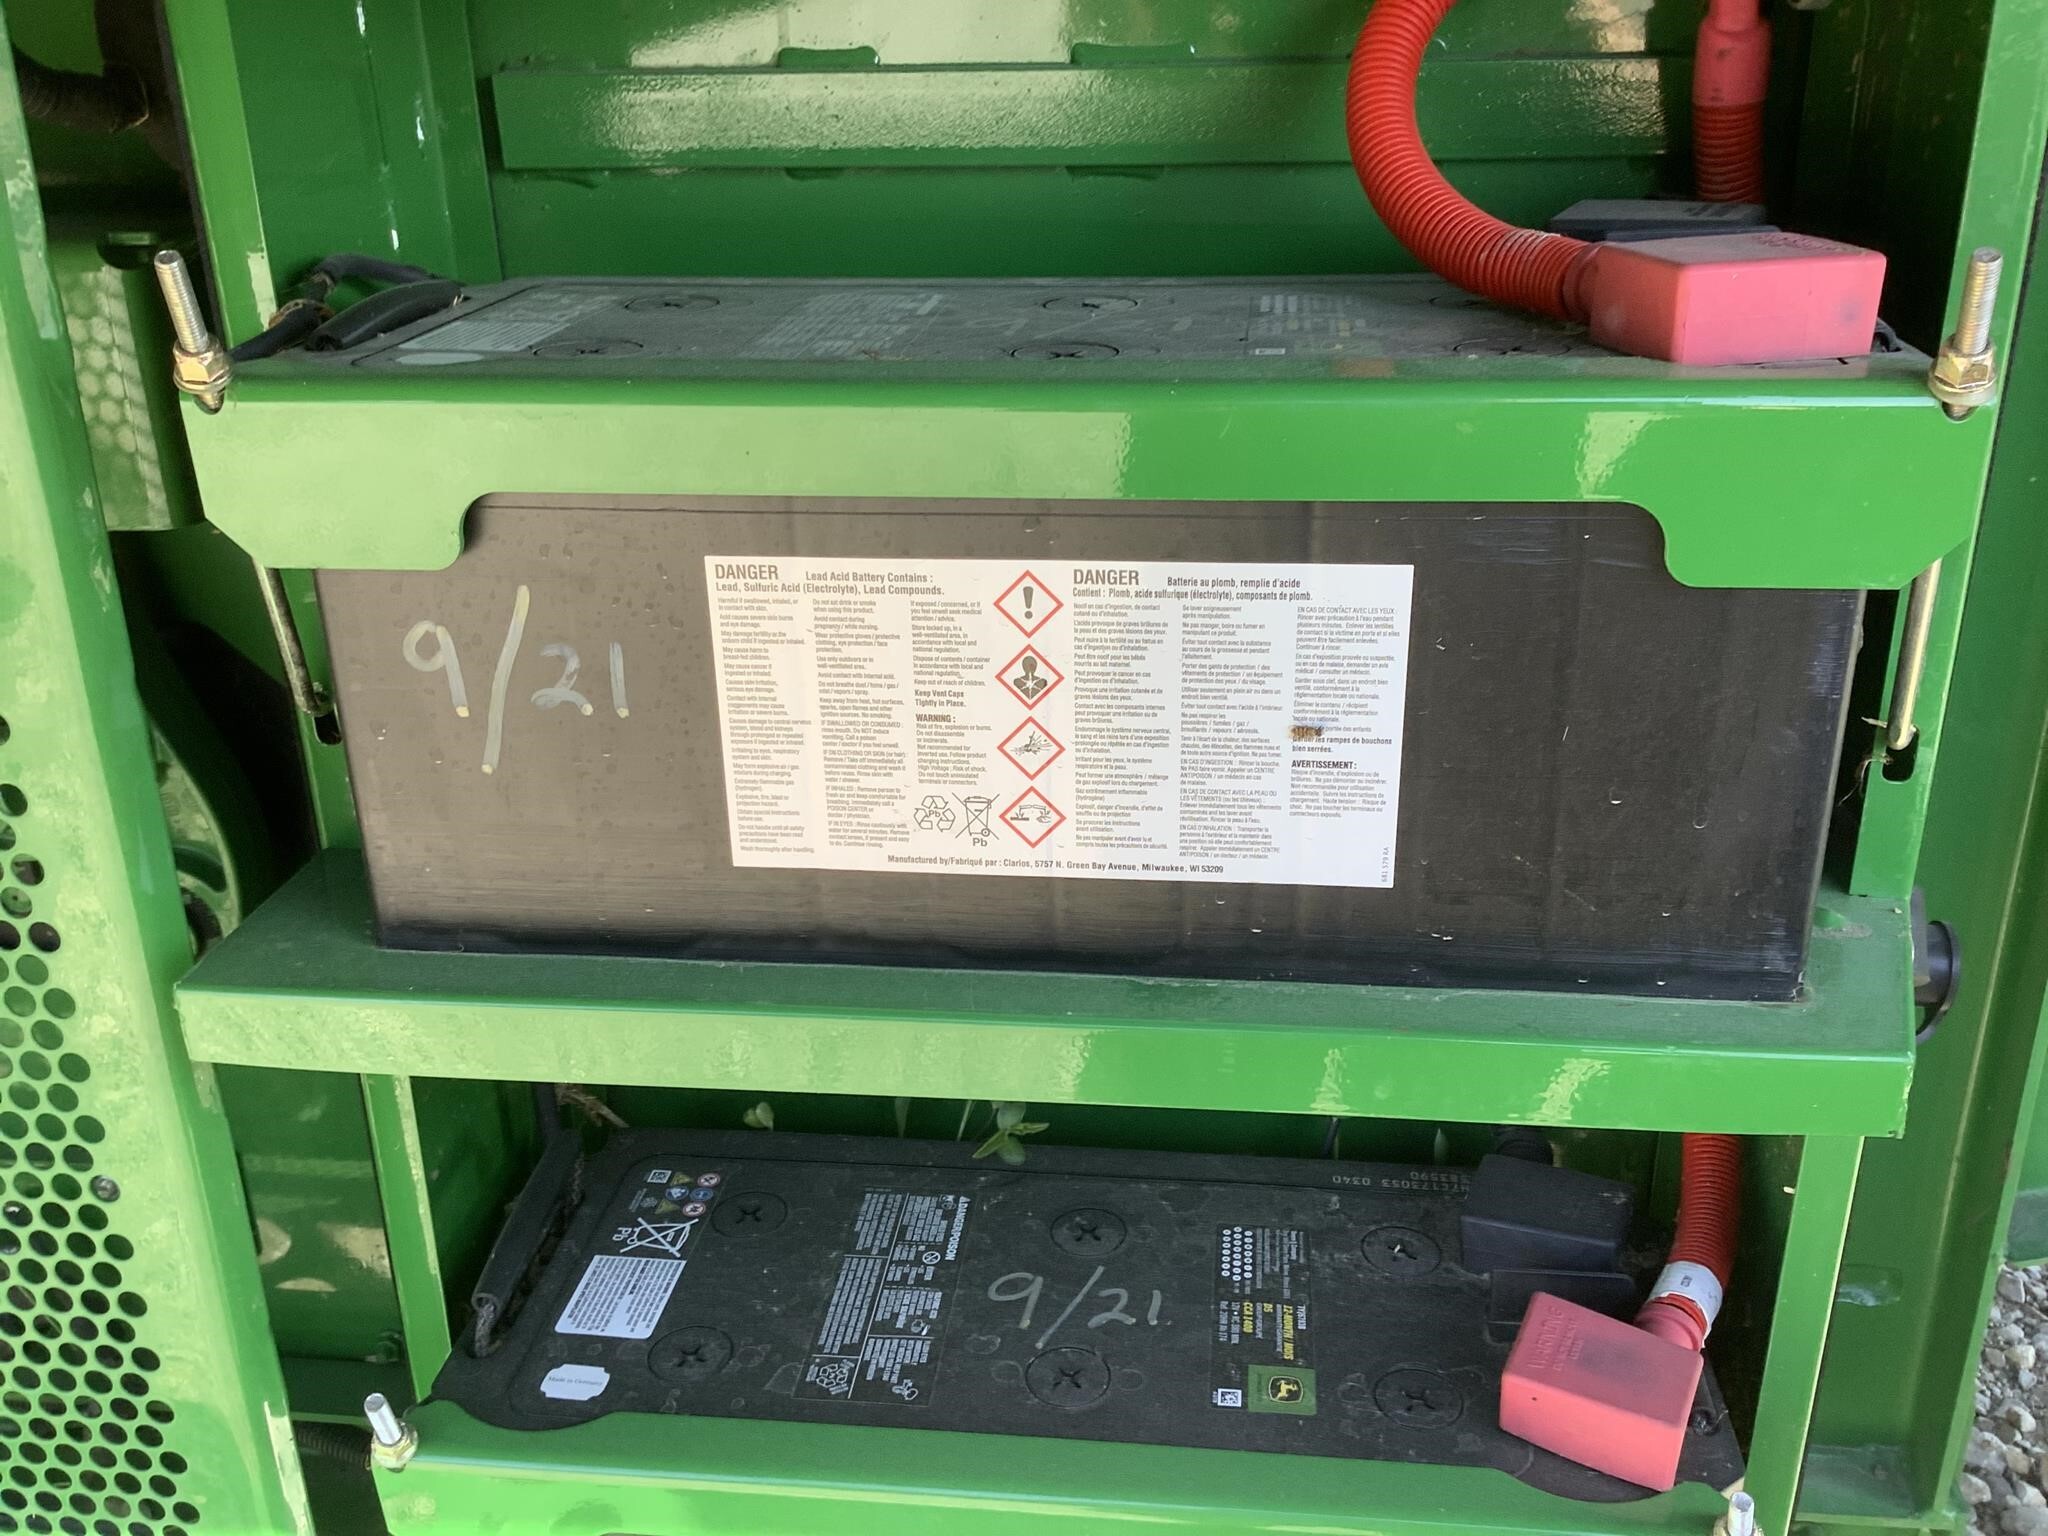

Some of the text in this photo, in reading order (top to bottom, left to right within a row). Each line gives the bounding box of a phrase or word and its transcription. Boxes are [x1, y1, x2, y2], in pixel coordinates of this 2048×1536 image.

[714, 563, 779, 580] DANGER
[805, 571, 828, 581] Lead
[829, 571, 849, 581] Acid
[851, 571, 885, 584] Battery
[887, 572, 927, 582] Contains
[1073, 568, 1301, 590] DANGER Batterie au plomb, remplie d'acide
[715, 581, 946, 597] Lead, Sulfuric Acid (Electrolyte), Lead Compounds.
[1072, 587, 1101, 598] Contient
[1108, 587, 1132, 599] Plomb,
[1134, 588, 1152, 598] acide
[1154, 588, 1188, 601] sulfurique
[1189, 588, 1234, 602] (électrolyte),
[1235, 591, 1277, 602] composants
[1278, 590, 1287, 600] de
[1288, 590, 1313, 603] plomb.
[403, 584, 629, 775] 9/21
[914, 689, 930, 697] Keep
[932, 689, 947, 697] Vent
[915, 698, 937, 707] Tightly
[945, 699, 966, 707] Place.
[915, 713, 951, 722] WARNING
[1291, 759, 1357, 769] AVERTISSEMENT:
[973, 838, 988, 847] Pb
[887, 855, 937, 864] Manufactured
[939, 856, 982, 867] by/Fabriqué
[984, 859, 997, 867] par
[1003, 858, 1032, 868] Clarios,
[1034, 859, 1053, 868] 5757
[1055, 860, 1063, 868] N.
[1066, 860, 1089, 869] Green
[1091, 861, 1106, 871] Bay
[1107, 862, 1139, 872] Avenue,
[1141, 863, 1187, 873] Milwaukee,
[1189, 864, 1199, 872] WI
[1201, 865, 1223, 873] 53209
[612, 1227, 632, 1241] Pb
[988, 1265, 1162, 1349] 9/21
